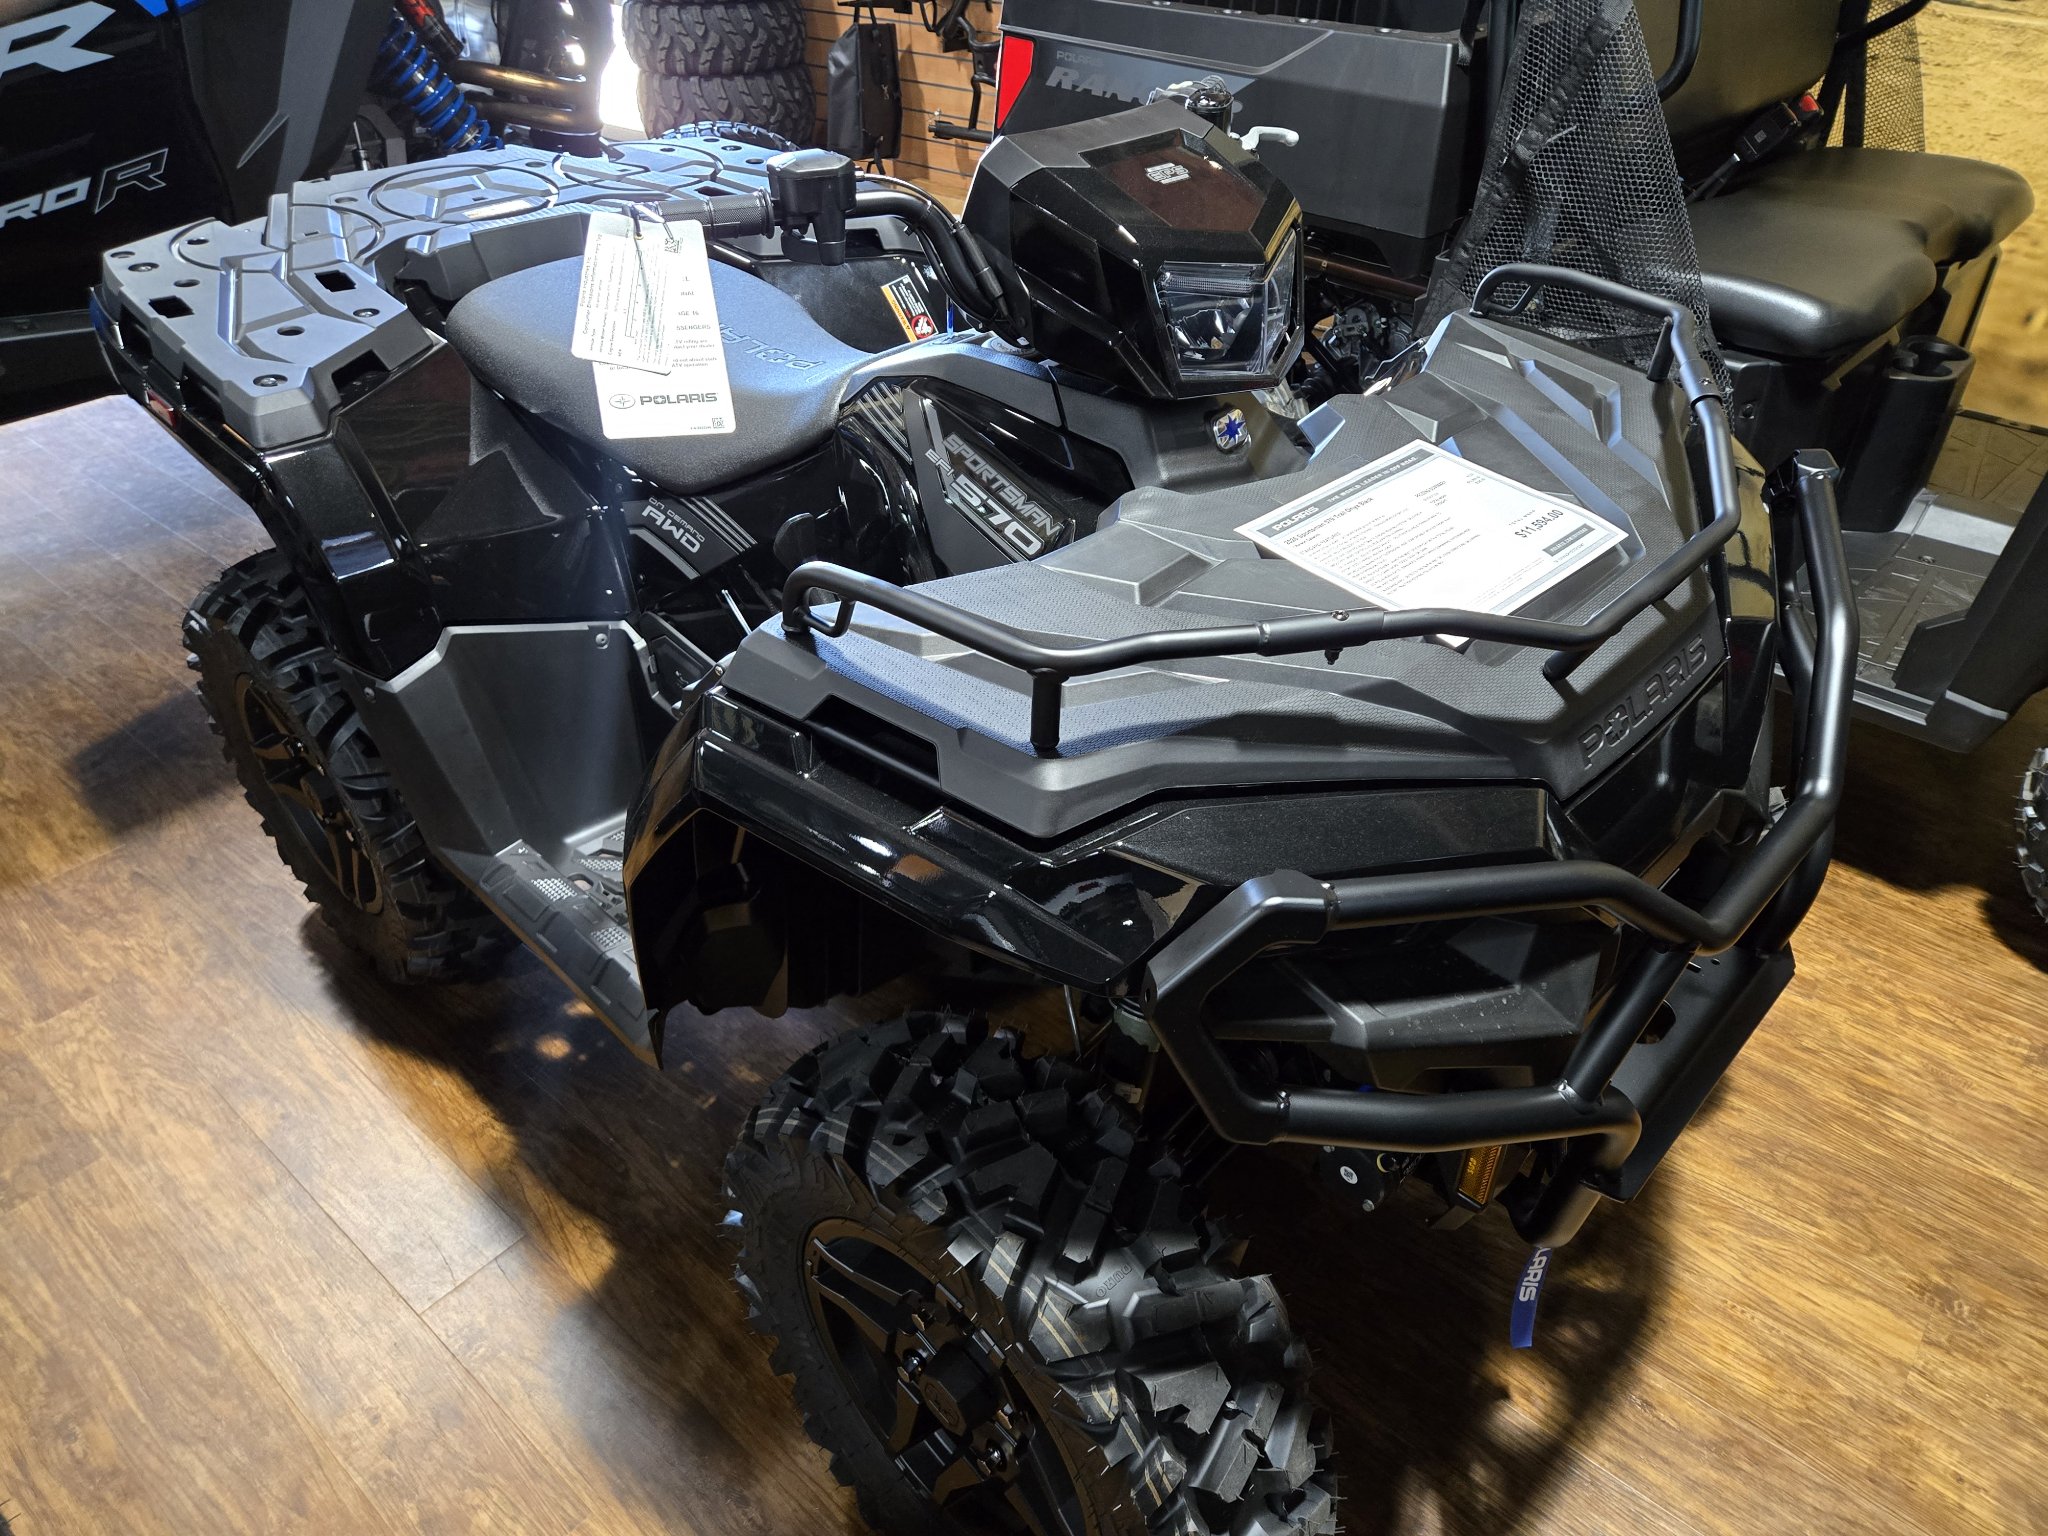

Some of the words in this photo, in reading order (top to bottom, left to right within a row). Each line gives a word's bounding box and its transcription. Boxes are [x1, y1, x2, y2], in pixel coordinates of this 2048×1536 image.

[1056, 50, 1104, 67] POLARIS
[676, 324, 711, 332] SSENGERS
[640, 393, 718, 406] POLARIS
[925, 448, 954, 477] EFI
[942, 433, 1062, 537] SPORTSMAN
[641, 505, 701, 553] AWD
[667, 509, 705, 543] DEMAND
[951, 474, 1043, 556] 570
[1271, 506, 1319, 532] POLARIS
[1514, 509, 1564, 539] $11,594.00
[1578, 634, 1708, 770] POLARIS
[1518, 1246, 1551, 1302] LARIS
